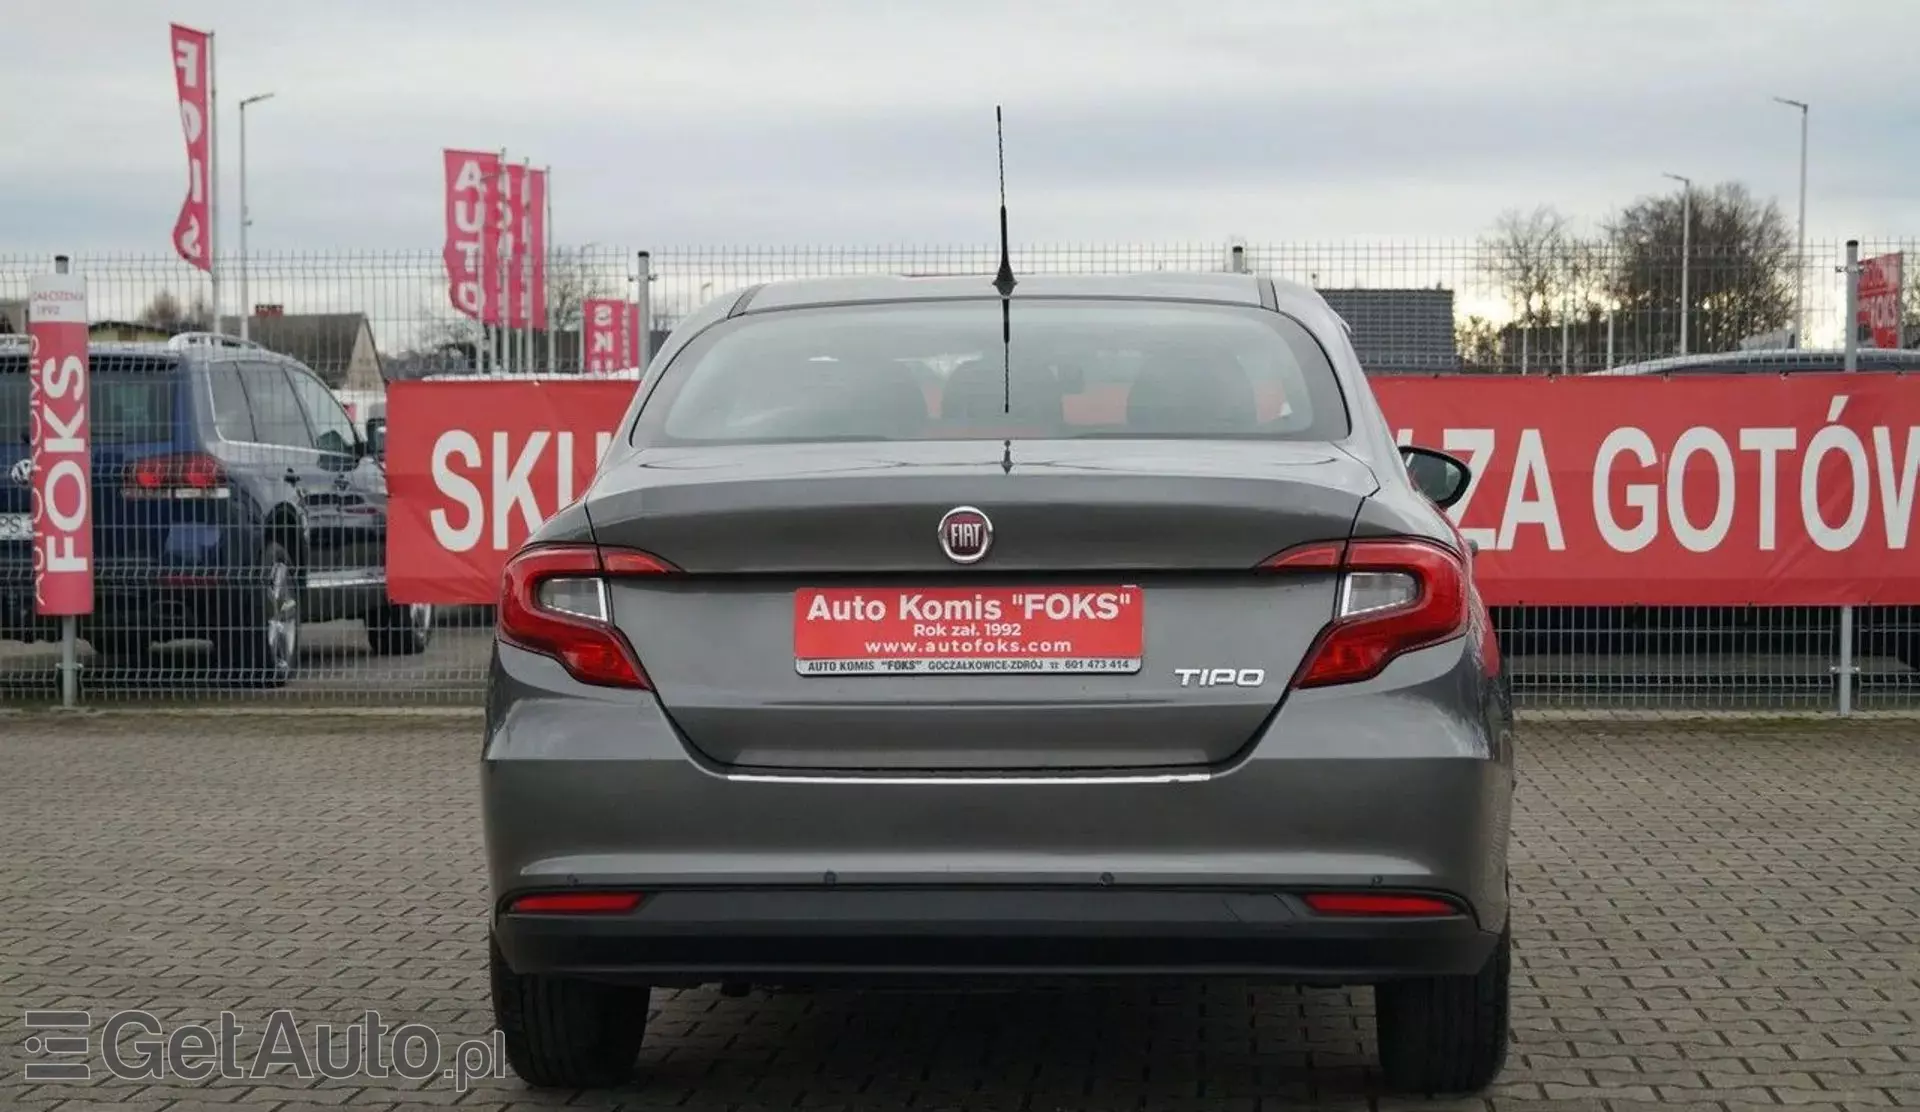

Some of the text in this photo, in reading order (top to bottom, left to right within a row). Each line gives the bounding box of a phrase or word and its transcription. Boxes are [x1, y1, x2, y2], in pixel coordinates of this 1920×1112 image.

[455, 160, 487, 313] AUTO
[42, 355, 88, 572] FOKS
[1443, 428, 1566, 550] ZA
[950, 523, 982, 548] FIAT
[806, 592, 1131, 621] Auto Komis "FOKS"
[913, 623, 1021, 637] Rok zał. 1992
[864, 638, 1072, 653] www.autofoks.com
[808, 661, 837, 672] AUTO
[839, 661, 874, 671] KOMIS
[1065, 659, 1084, 669] 601
[1087, 659, 1107, 669] 473
[1109, 659, 1129, 669] 414
[1174, 668, 1265, 687] TIPO
